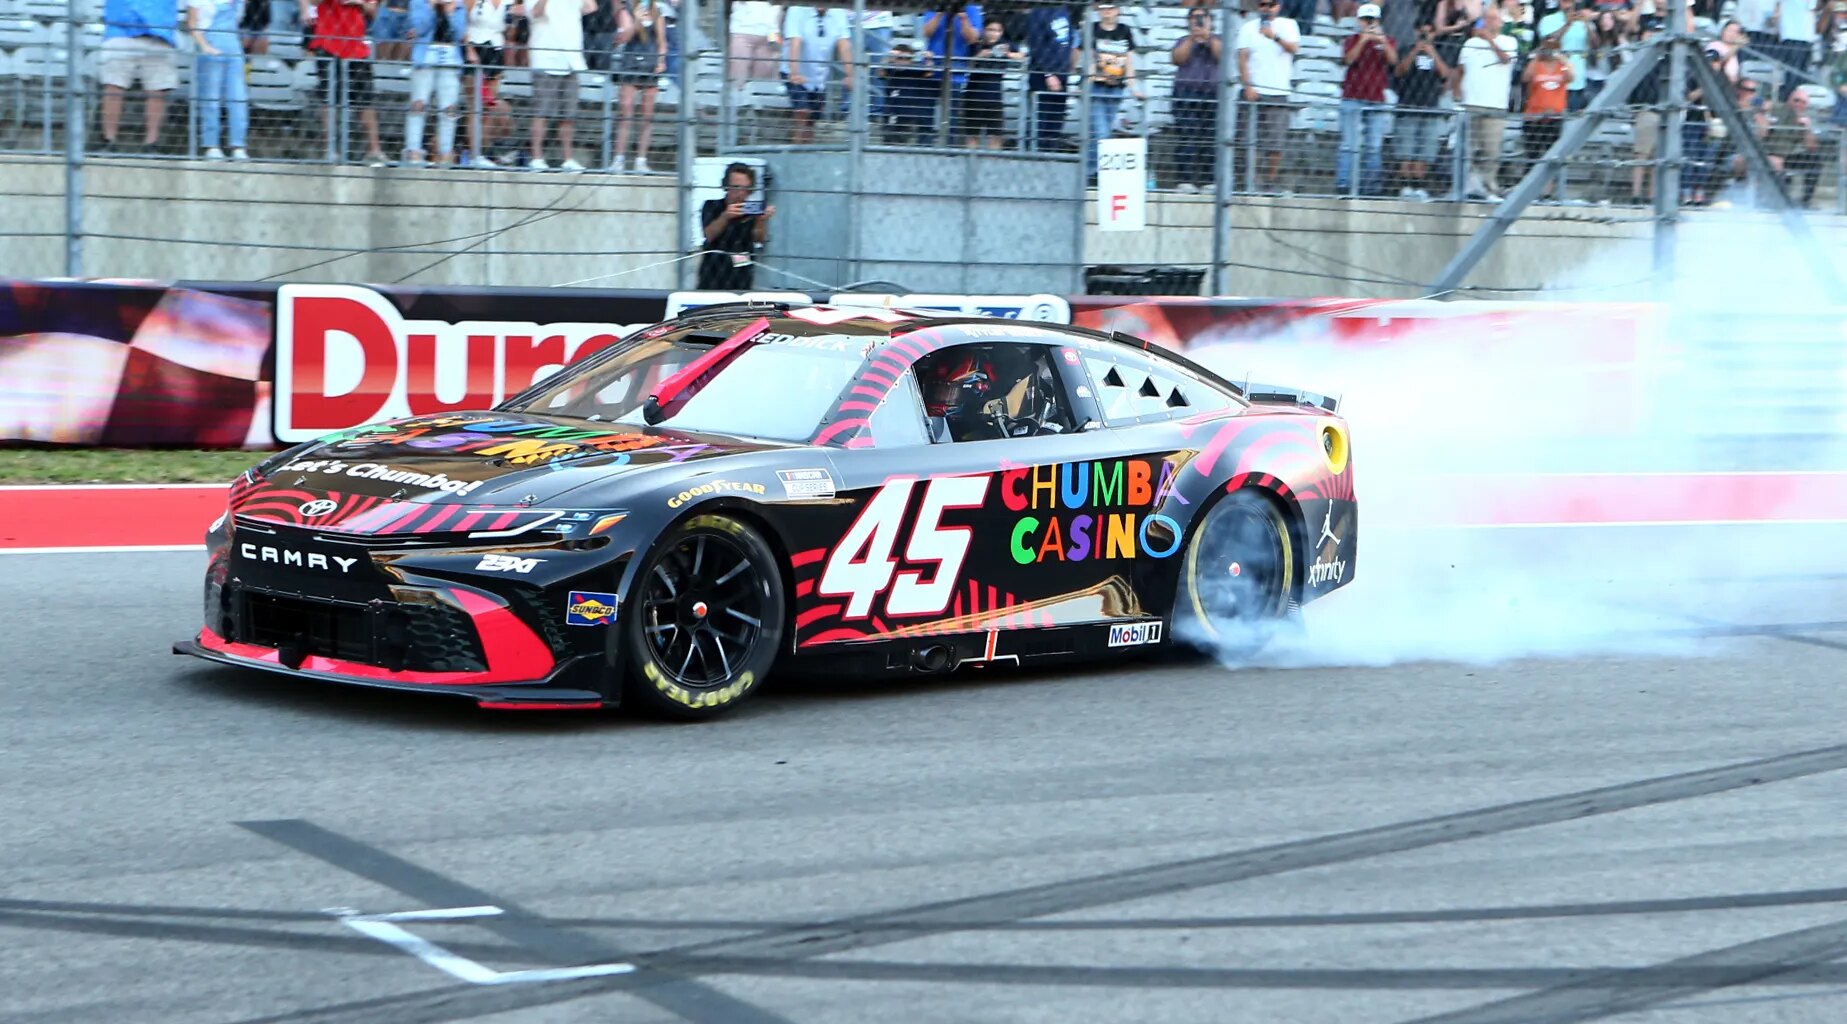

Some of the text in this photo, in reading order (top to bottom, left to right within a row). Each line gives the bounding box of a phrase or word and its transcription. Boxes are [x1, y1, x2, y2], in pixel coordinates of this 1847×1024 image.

[1111, 195, 1127, 221] F
[346, 463, 484, 497] Chumba!
[667, 479, 766, 509] GOODYEAR
[1001, 459, 1191, 512] CHUMBA
[819, 474, 992, 621] 45
[1010, 513, 1183, 566] CASINO
[241, 543, 359, 573] CAMRY
[1307, 555, 1346, 588] xfinity
[572, 605, 614, 615] SUNOCO
[1110, 625, 1147, 645] Mobil
